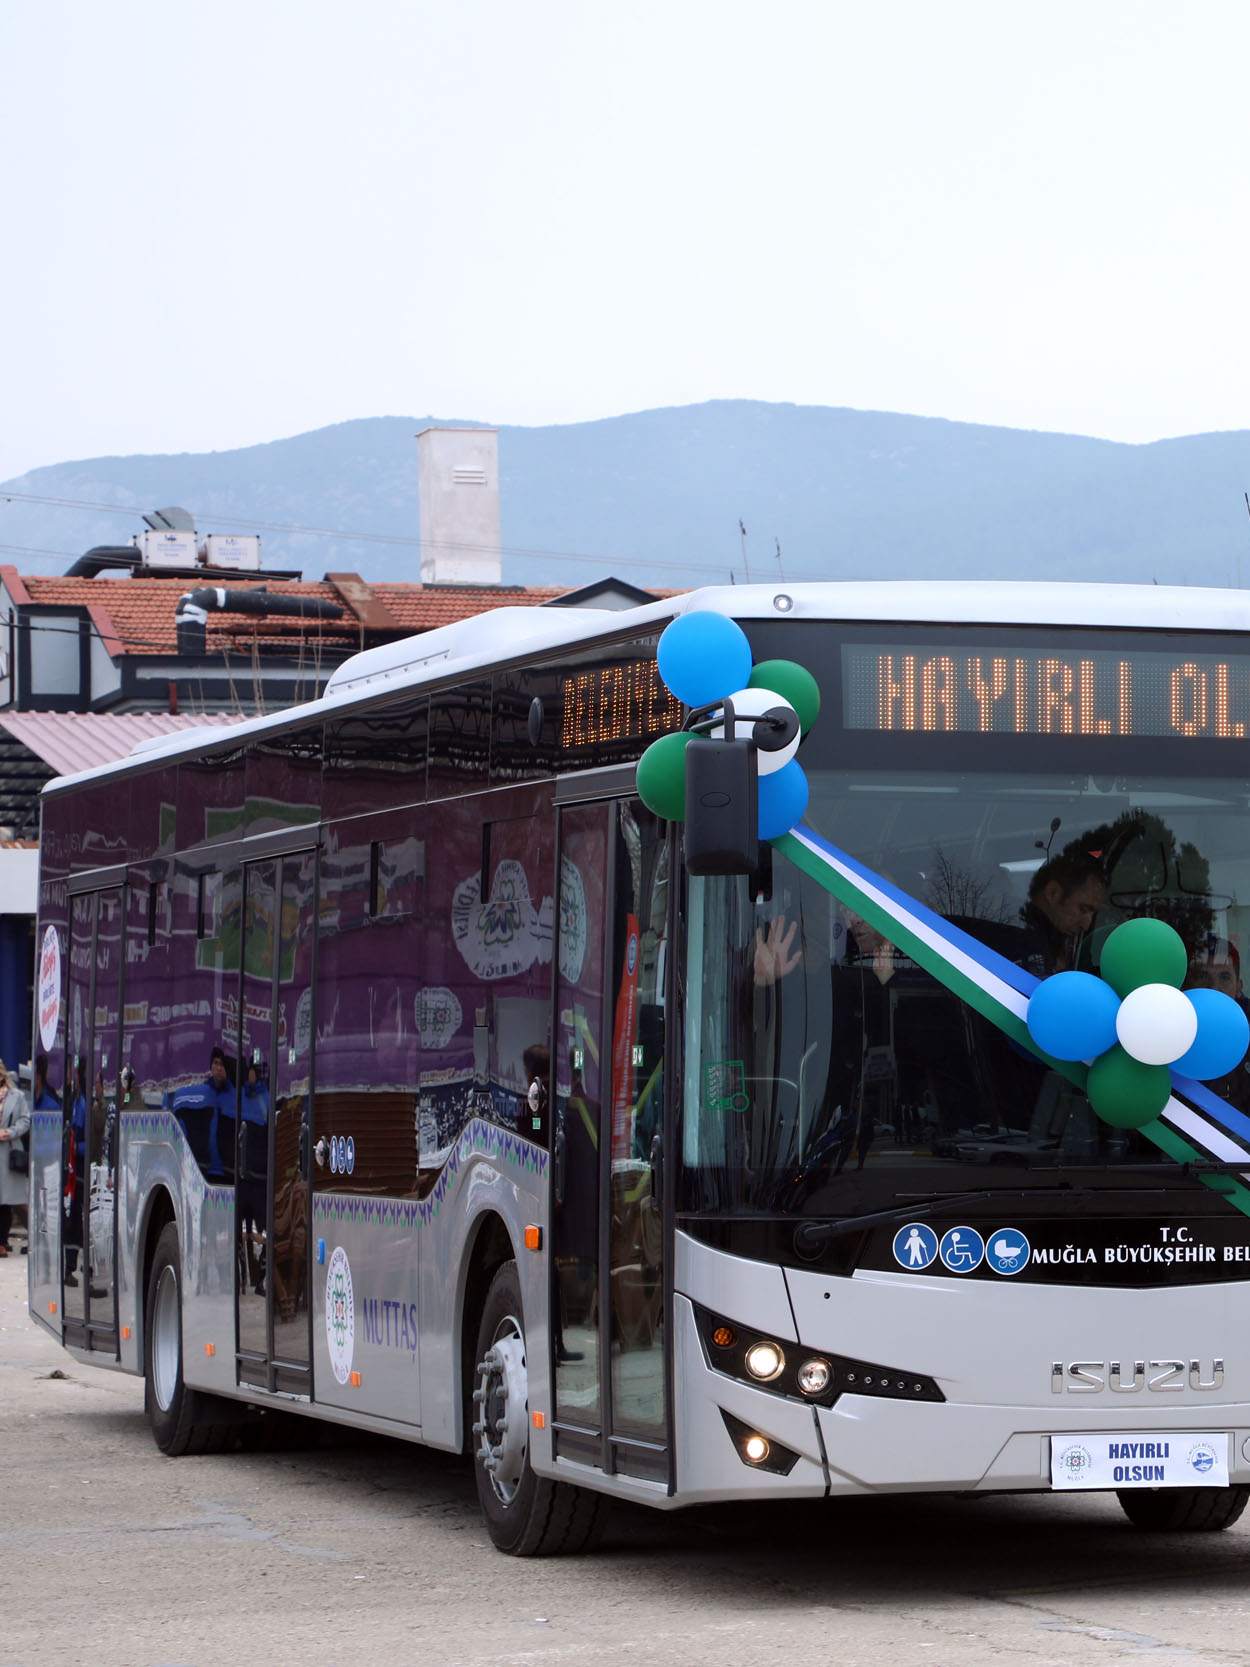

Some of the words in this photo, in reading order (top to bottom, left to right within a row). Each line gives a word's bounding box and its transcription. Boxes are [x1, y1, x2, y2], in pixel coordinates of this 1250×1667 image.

[877, 655, 1133, 735] HAYIRLI
[1159, 1227, 1194, 1243] T.C.
[1031, 1244, 1098, 1264] MUĞLA
[1104, 1244, 1216, 1266] BÜYÜKŞEHİR
[363, 1297, 418, 1364] MUTTAŞ
[1052, 1358, 1225, 1394] ISUZU
[1108, 1442, 1170, 1459] HAYIRLI
[1113, 1465, 1165, 1482] OLSUN
